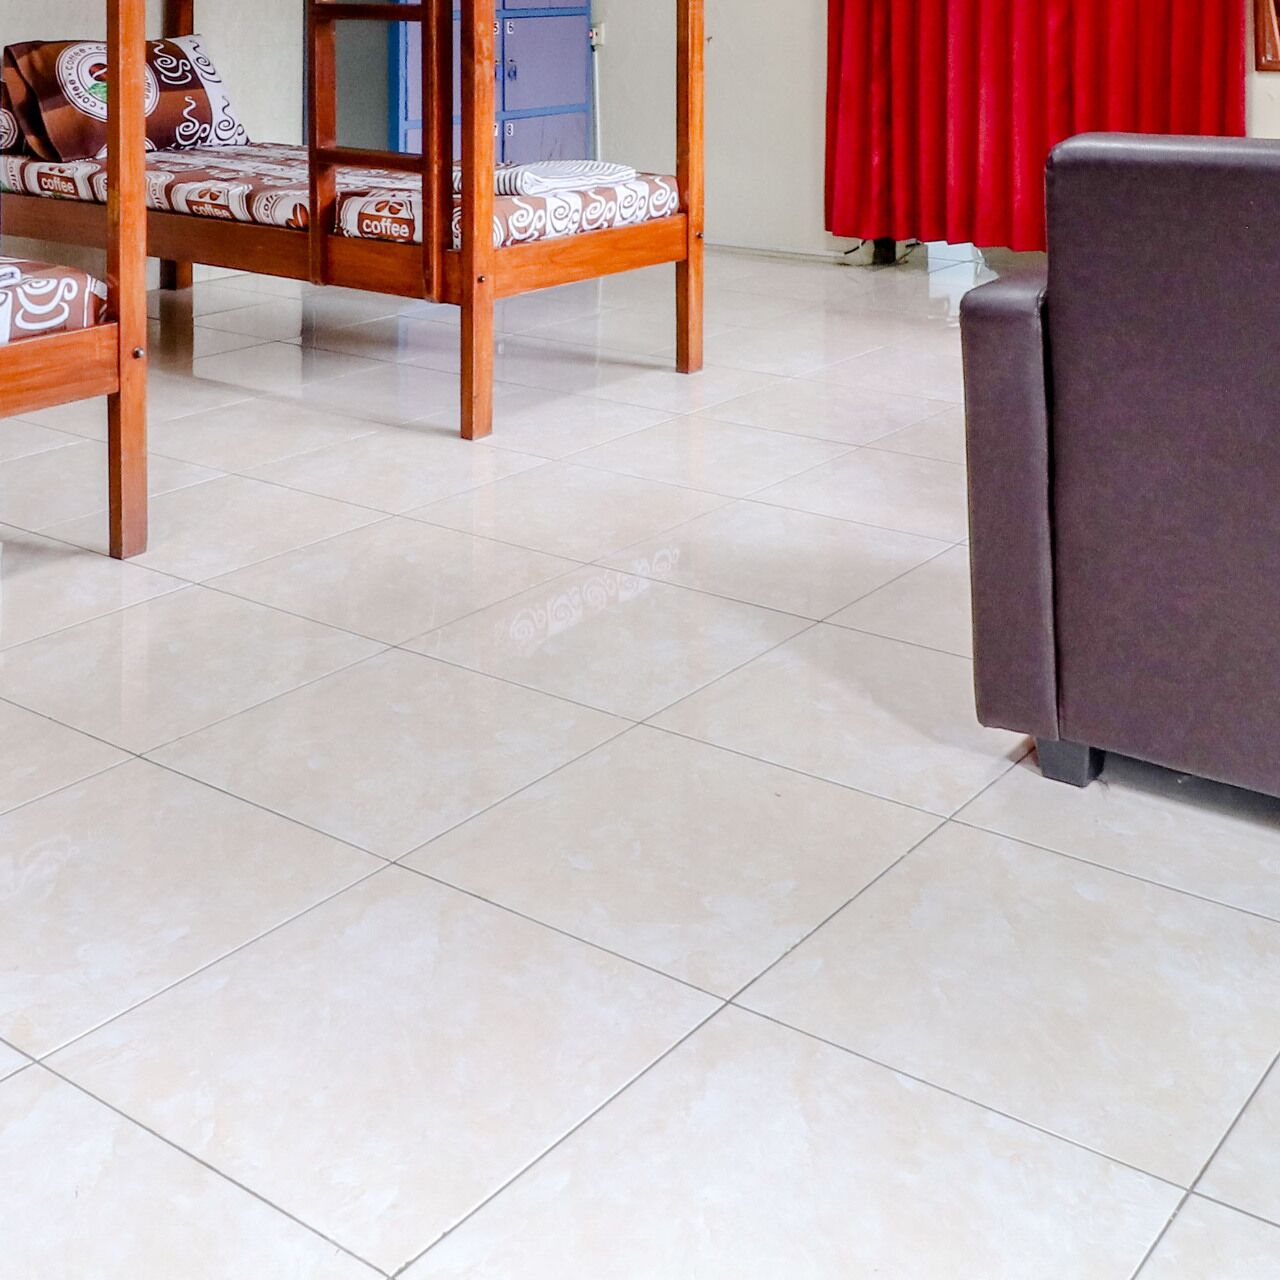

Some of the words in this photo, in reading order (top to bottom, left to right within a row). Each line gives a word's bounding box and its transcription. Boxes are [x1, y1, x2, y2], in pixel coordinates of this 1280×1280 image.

[69, 79, 97, 108] coffee
[40, 176, 75, 193] coffee
[362, 217, 410, 237] coffee
